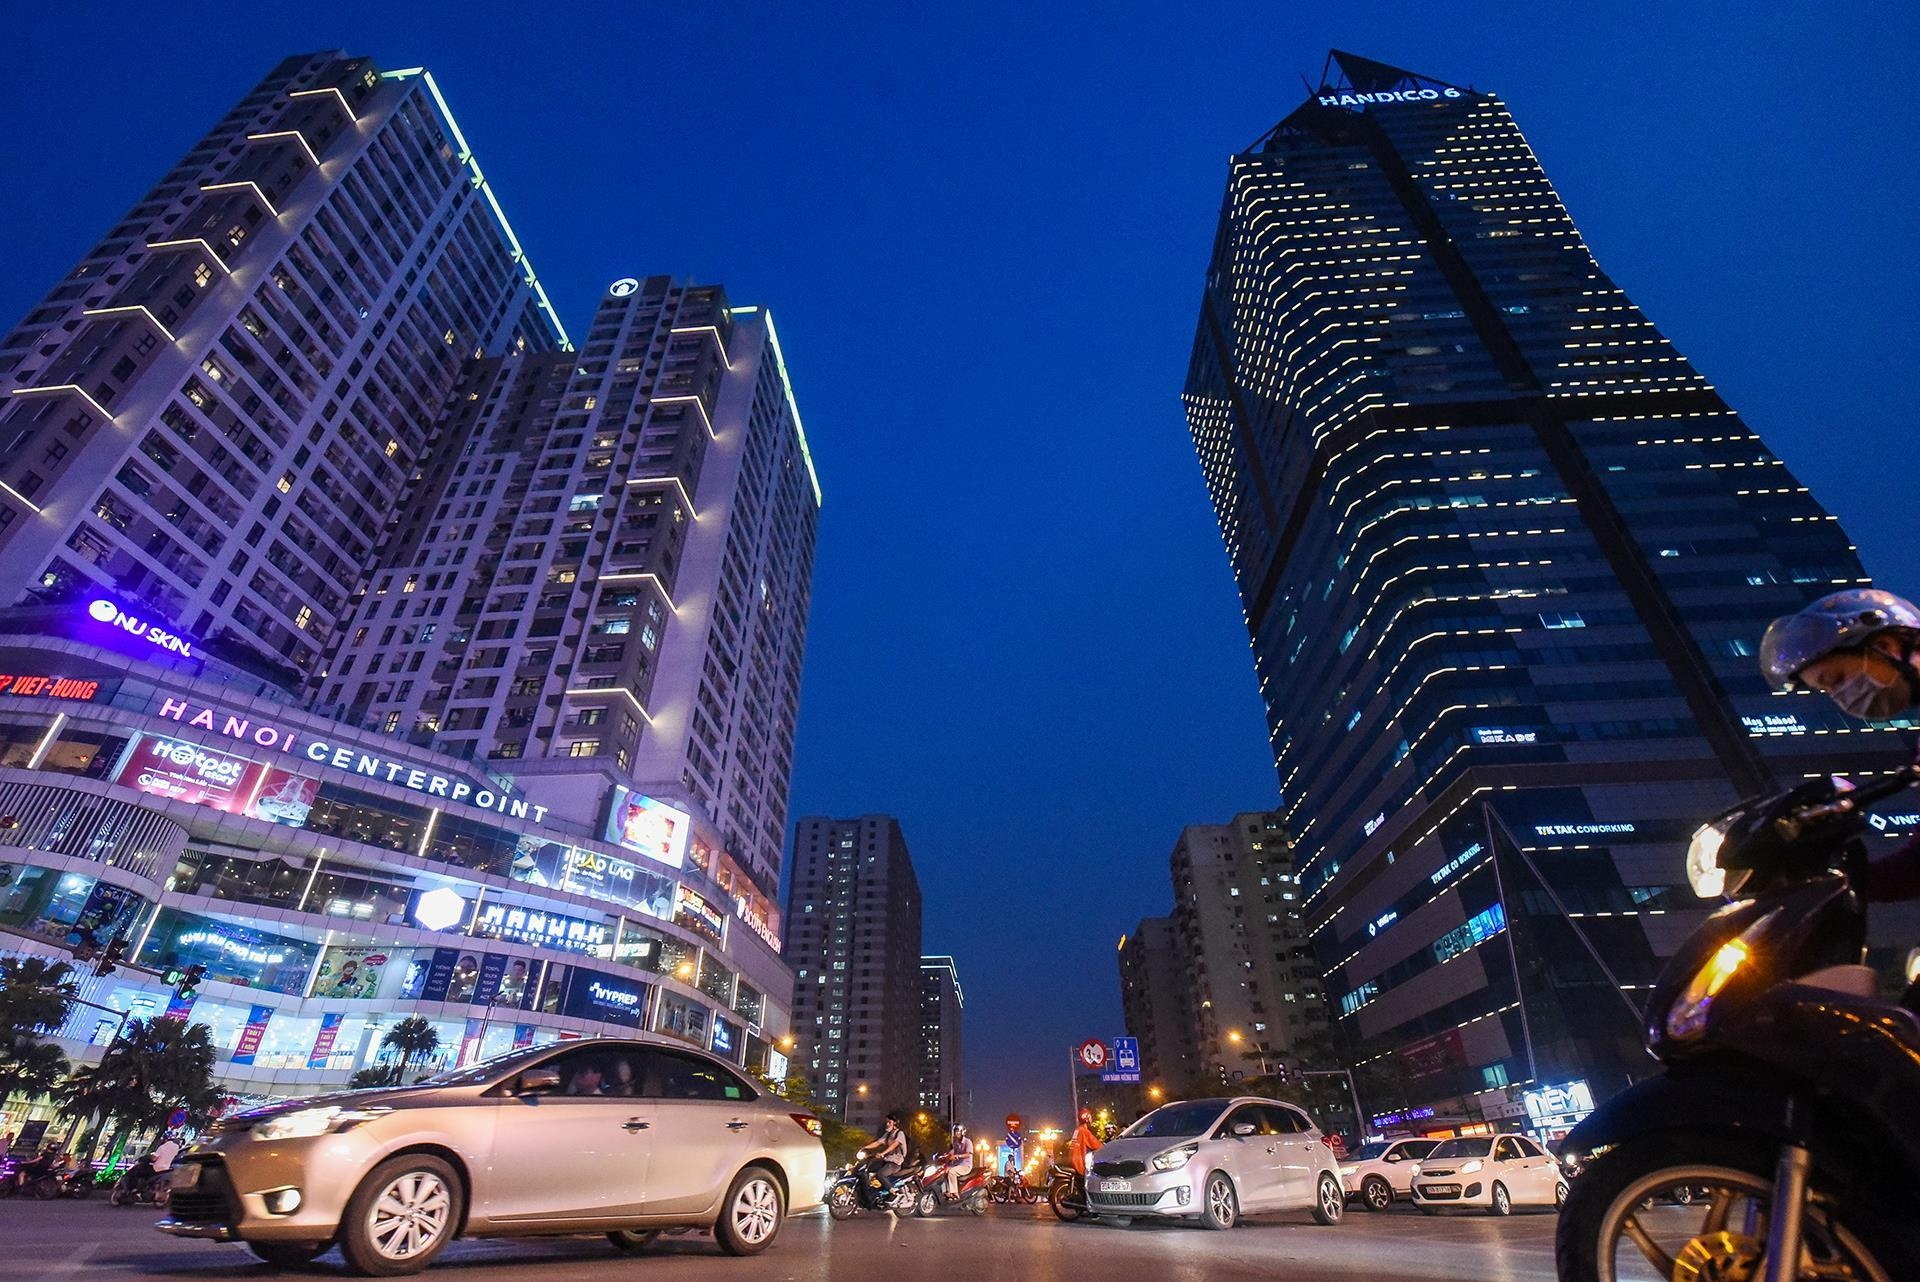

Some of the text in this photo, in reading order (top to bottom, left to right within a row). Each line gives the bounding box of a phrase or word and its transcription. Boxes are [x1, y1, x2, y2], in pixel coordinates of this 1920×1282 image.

[1319, 87, 1461, 106] HANDICO 6
[114, 612, 147, 635] NU
[11, 676, 99, 699] VIET-HUNG
[158, 697, 548, 824] HANOI CENTERPOINT
[1554, 825, 1577, 835] TAK
[1576, 824, 1635, 833] COWORKING
[485, 905, 605, 944] MANWAH
[744, 904, 761, 935] SCOTS
[482, 924, 551, 944] TAIWANESE
